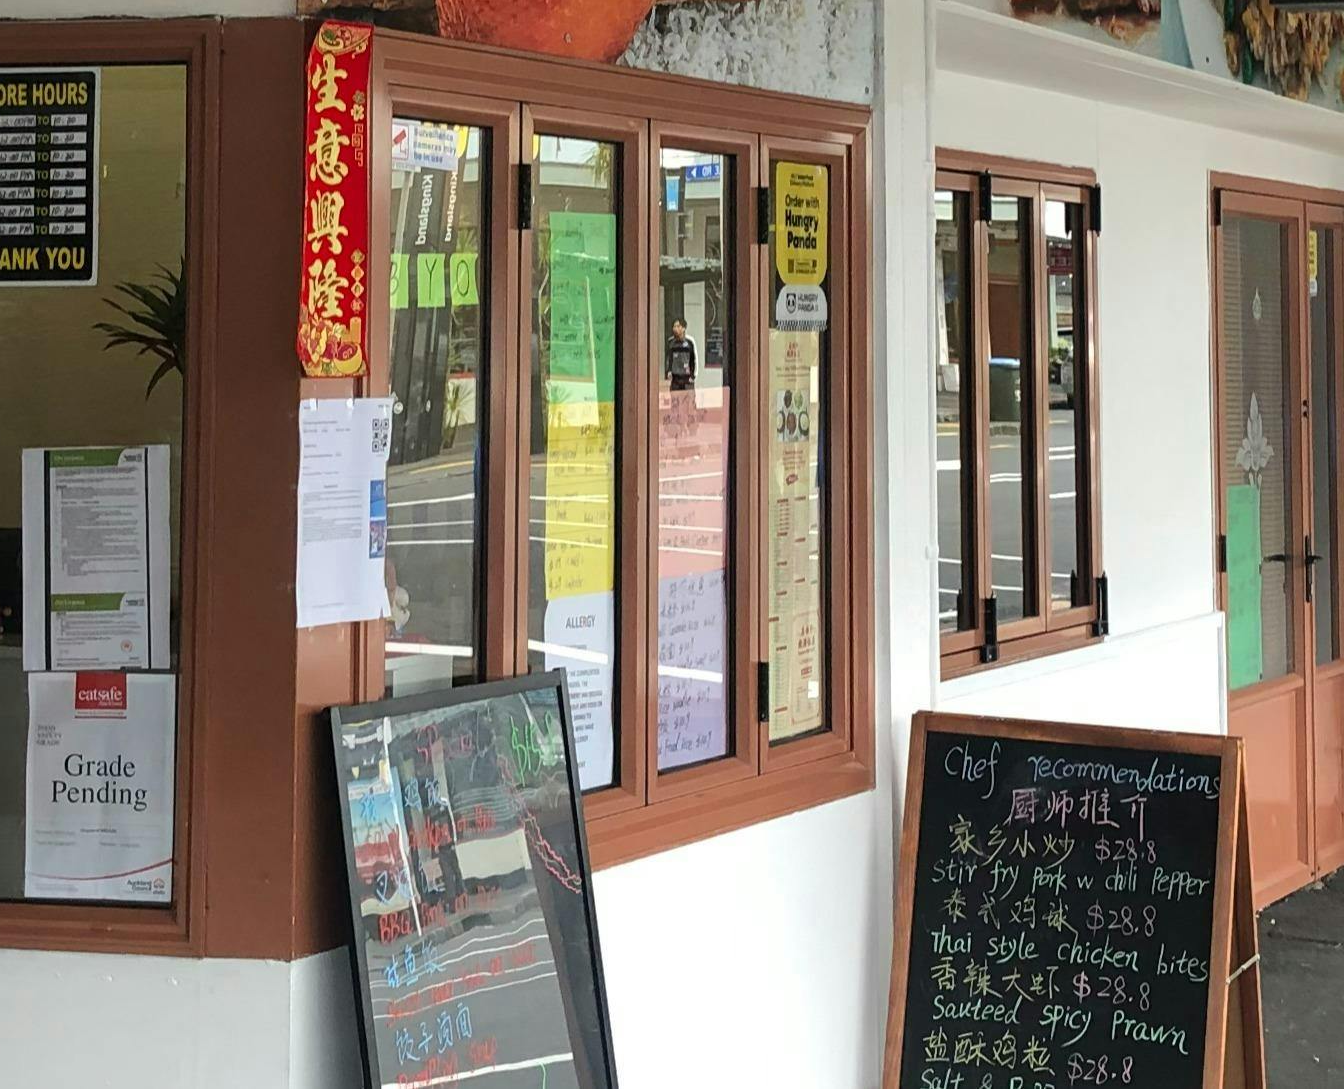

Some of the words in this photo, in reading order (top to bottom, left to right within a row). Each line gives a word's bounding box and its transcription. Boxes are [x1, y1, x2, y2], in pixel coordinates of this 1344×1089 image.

[32, 82, 88, 105] HOURS
[37, 116, 50, 125] TO
[37, 134, 49, 143] TO
[36, 152, 49, 161] TO
[36, 170, 49, 179] TO
[306, 54, 351, 317] 生意興隆
[36, 189, 48, 197] TO
[785, 194, 805, 208] Order
[806, 196, 819, 208] with
[36, 207, 48, 216] TO
[785, 209, 819, 232] Hungry
[35, 225, 48, 234] TO
[787, 231, 817, 250] Panda
[45, 247, 85, 270] YOU
[566, 615, 596, 629] ALLERGY
[64, 753, 136, 779] Grade
[945, 741, 1001, 799] Chef
[1028, 756, 1221, 800] recommendations
[51, 780, 148, 811] Pending
[1005, 788, 1147, 842] 厨师推介
[949, 814, 1076, 870] 家乡小炒
[1095, 838, 1157, 864] $28.8
[932, 861, 979, 884] Stir
[989, 860, 1020, 900] fry
[1106, 861, 1137, 892] chili
[944, 888, 1079, 941] 泰式鸡球
[1087, 898, 1157, 937] $28.8
[931, 930, 972, 956] Thai
[1058, 935, 1139, 972] chicken
[1157, 943, 1208, 983] bites
[931, 957, 1061, 1003] 香辣大虾
[1073, 970, 1151, 1011] $28.8
[933, 996, 1023, 1024] Sauteed
[1067, 1052, 1134, 1085] $28.8
